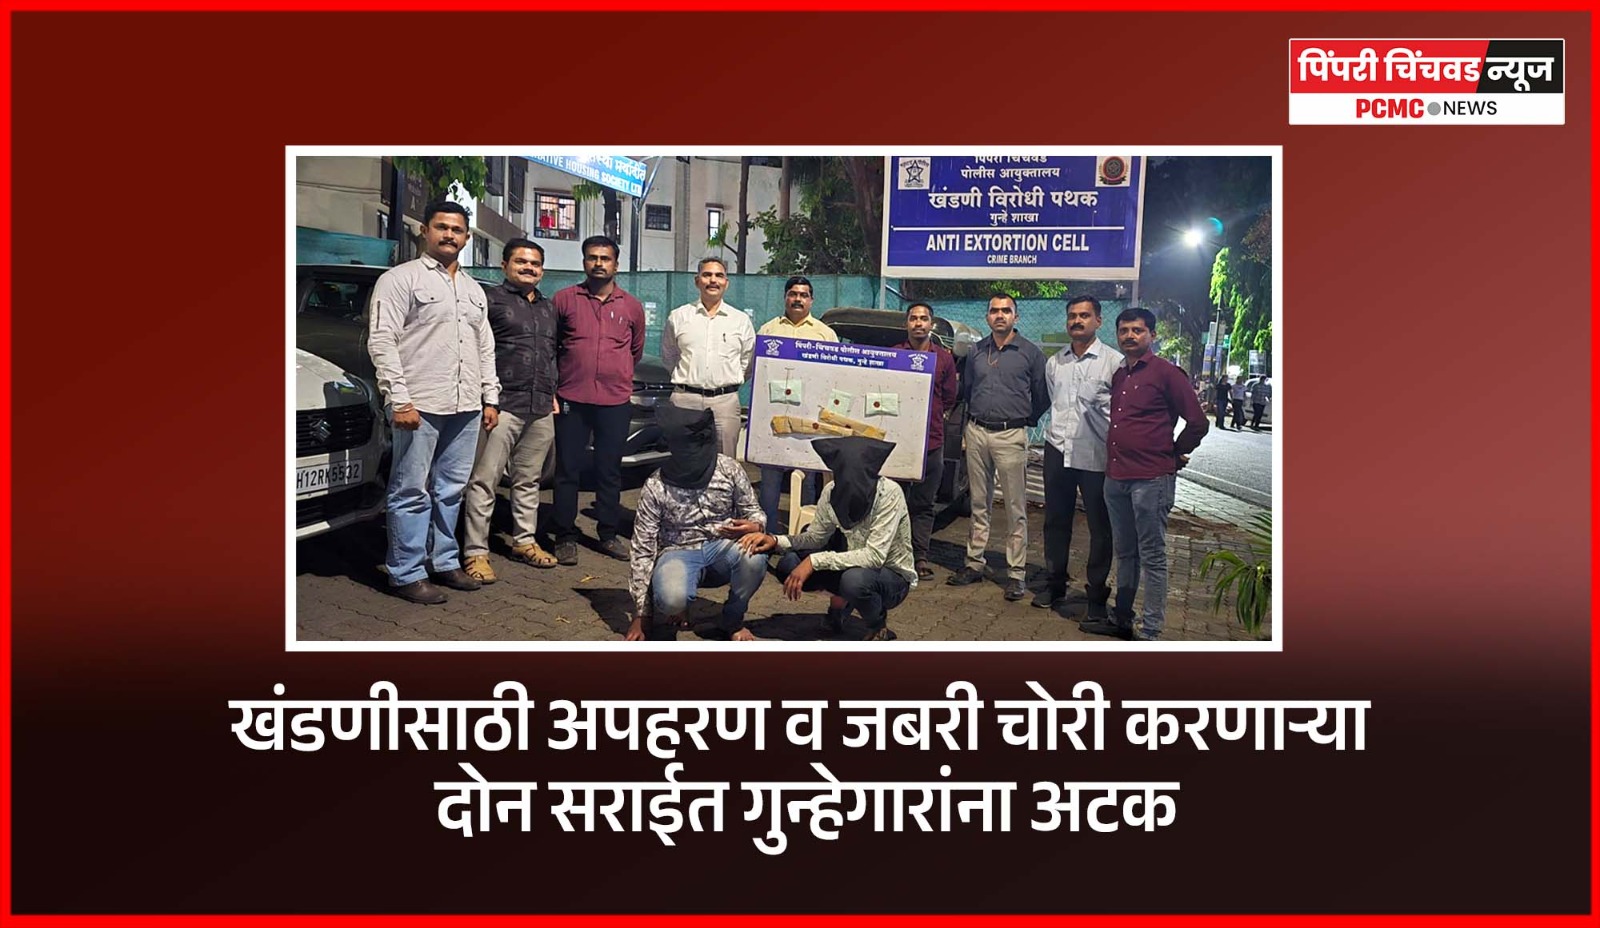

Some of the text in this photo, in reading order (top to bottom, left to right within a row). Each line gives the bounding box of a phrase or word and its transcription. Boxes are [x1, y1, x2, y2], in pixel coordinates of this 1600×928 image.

[566, 158, 599, 180] HOUSING
[601, 171, 629, 191] SOCIETY
[961, 165, 1060, 182] पोलीस आयुक्तालय
[928, 185, 1098, 209] खंडणी विरोधी पथक
[989, 210, 1039, 227] गुन्हे शाखा
[926, 234, 1089, 251] ANTI EXTORTION CELL
[987, 254, 1037, 264] CRIME BRANCH
